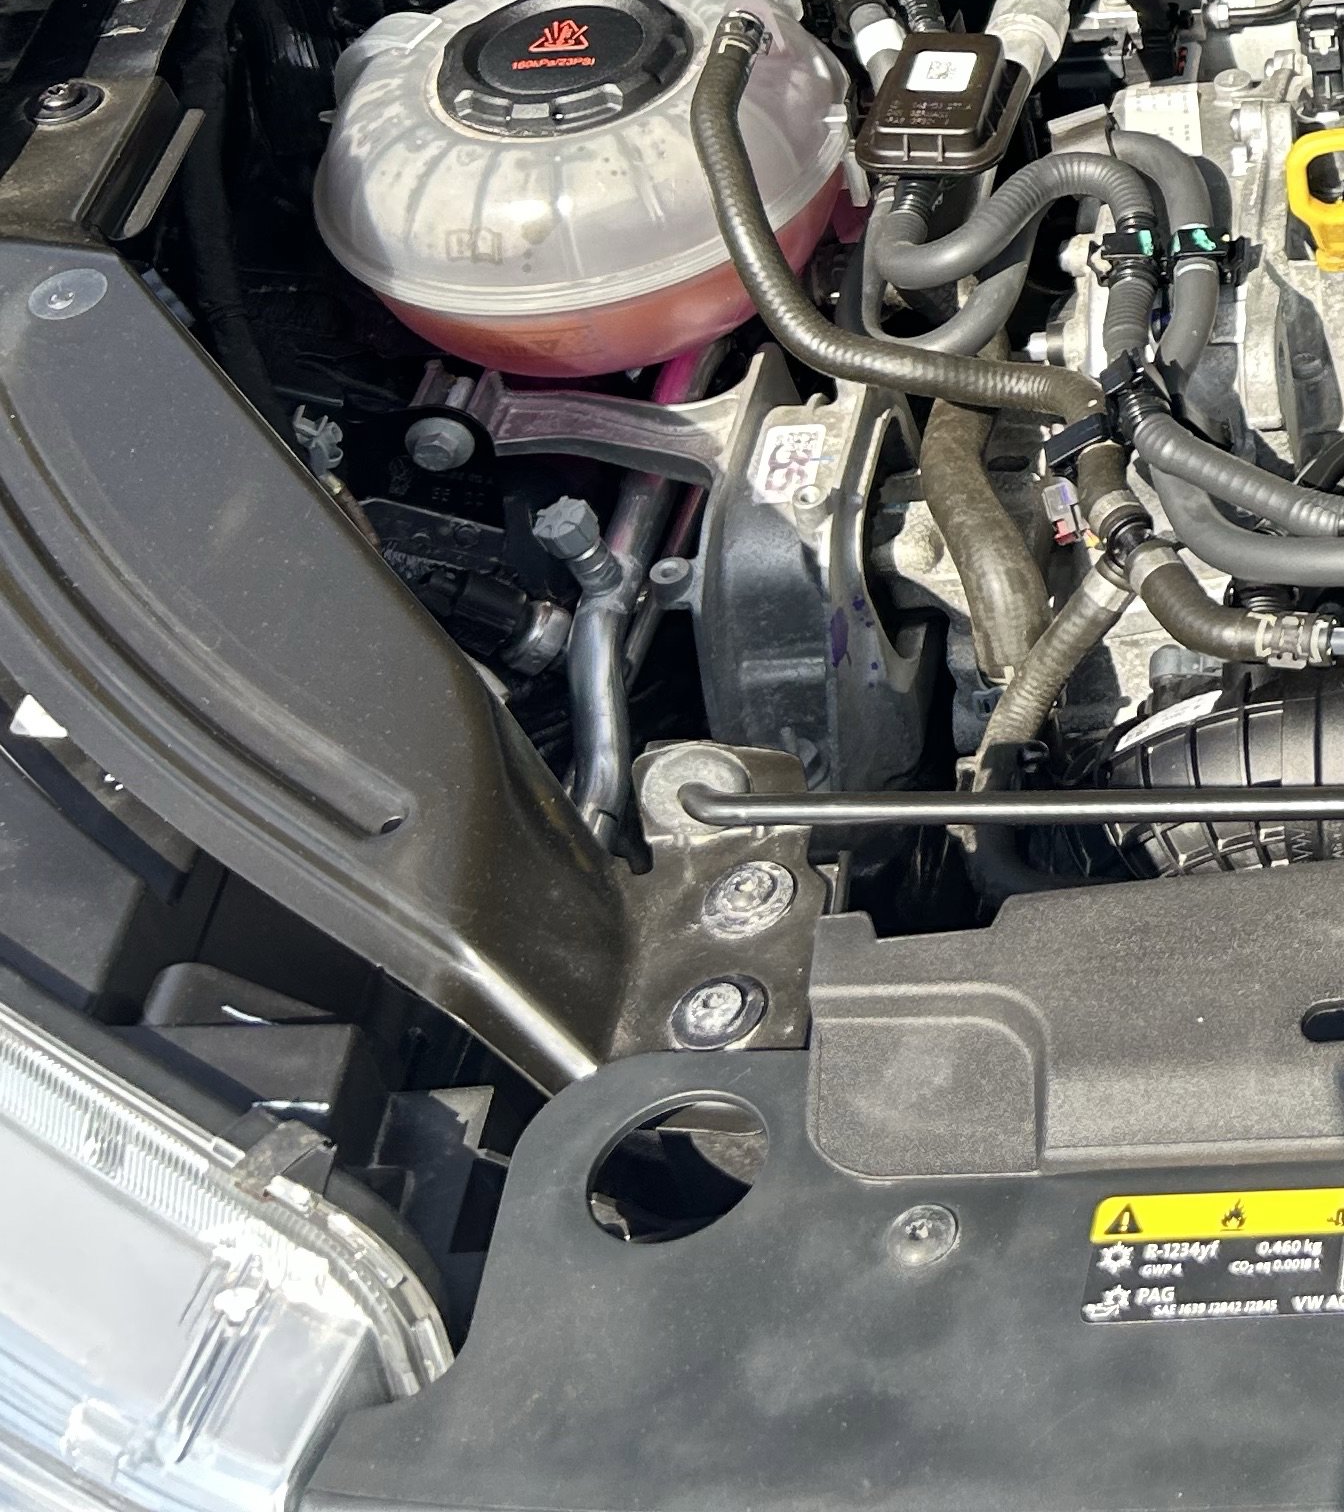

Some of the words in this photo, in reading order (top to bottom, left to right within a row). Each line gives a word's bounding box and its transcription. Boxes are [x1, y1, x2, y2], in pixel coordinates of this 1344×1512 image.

[1143, 1240, 1221, 1263] R-1234yf
[1256, 1240, 1302, 1257] 0.460
[1303, 1239, 1323, 1257] kg
[1139, 1264, 1171, 1276] GWP
[1172, 1263, 1183, 1277] 4
[1135, 1287, 1175, 1304] PAG
[1292, 1295, 1324, 1311] VW
[1153, 1304, 1177, 1317] SAE
